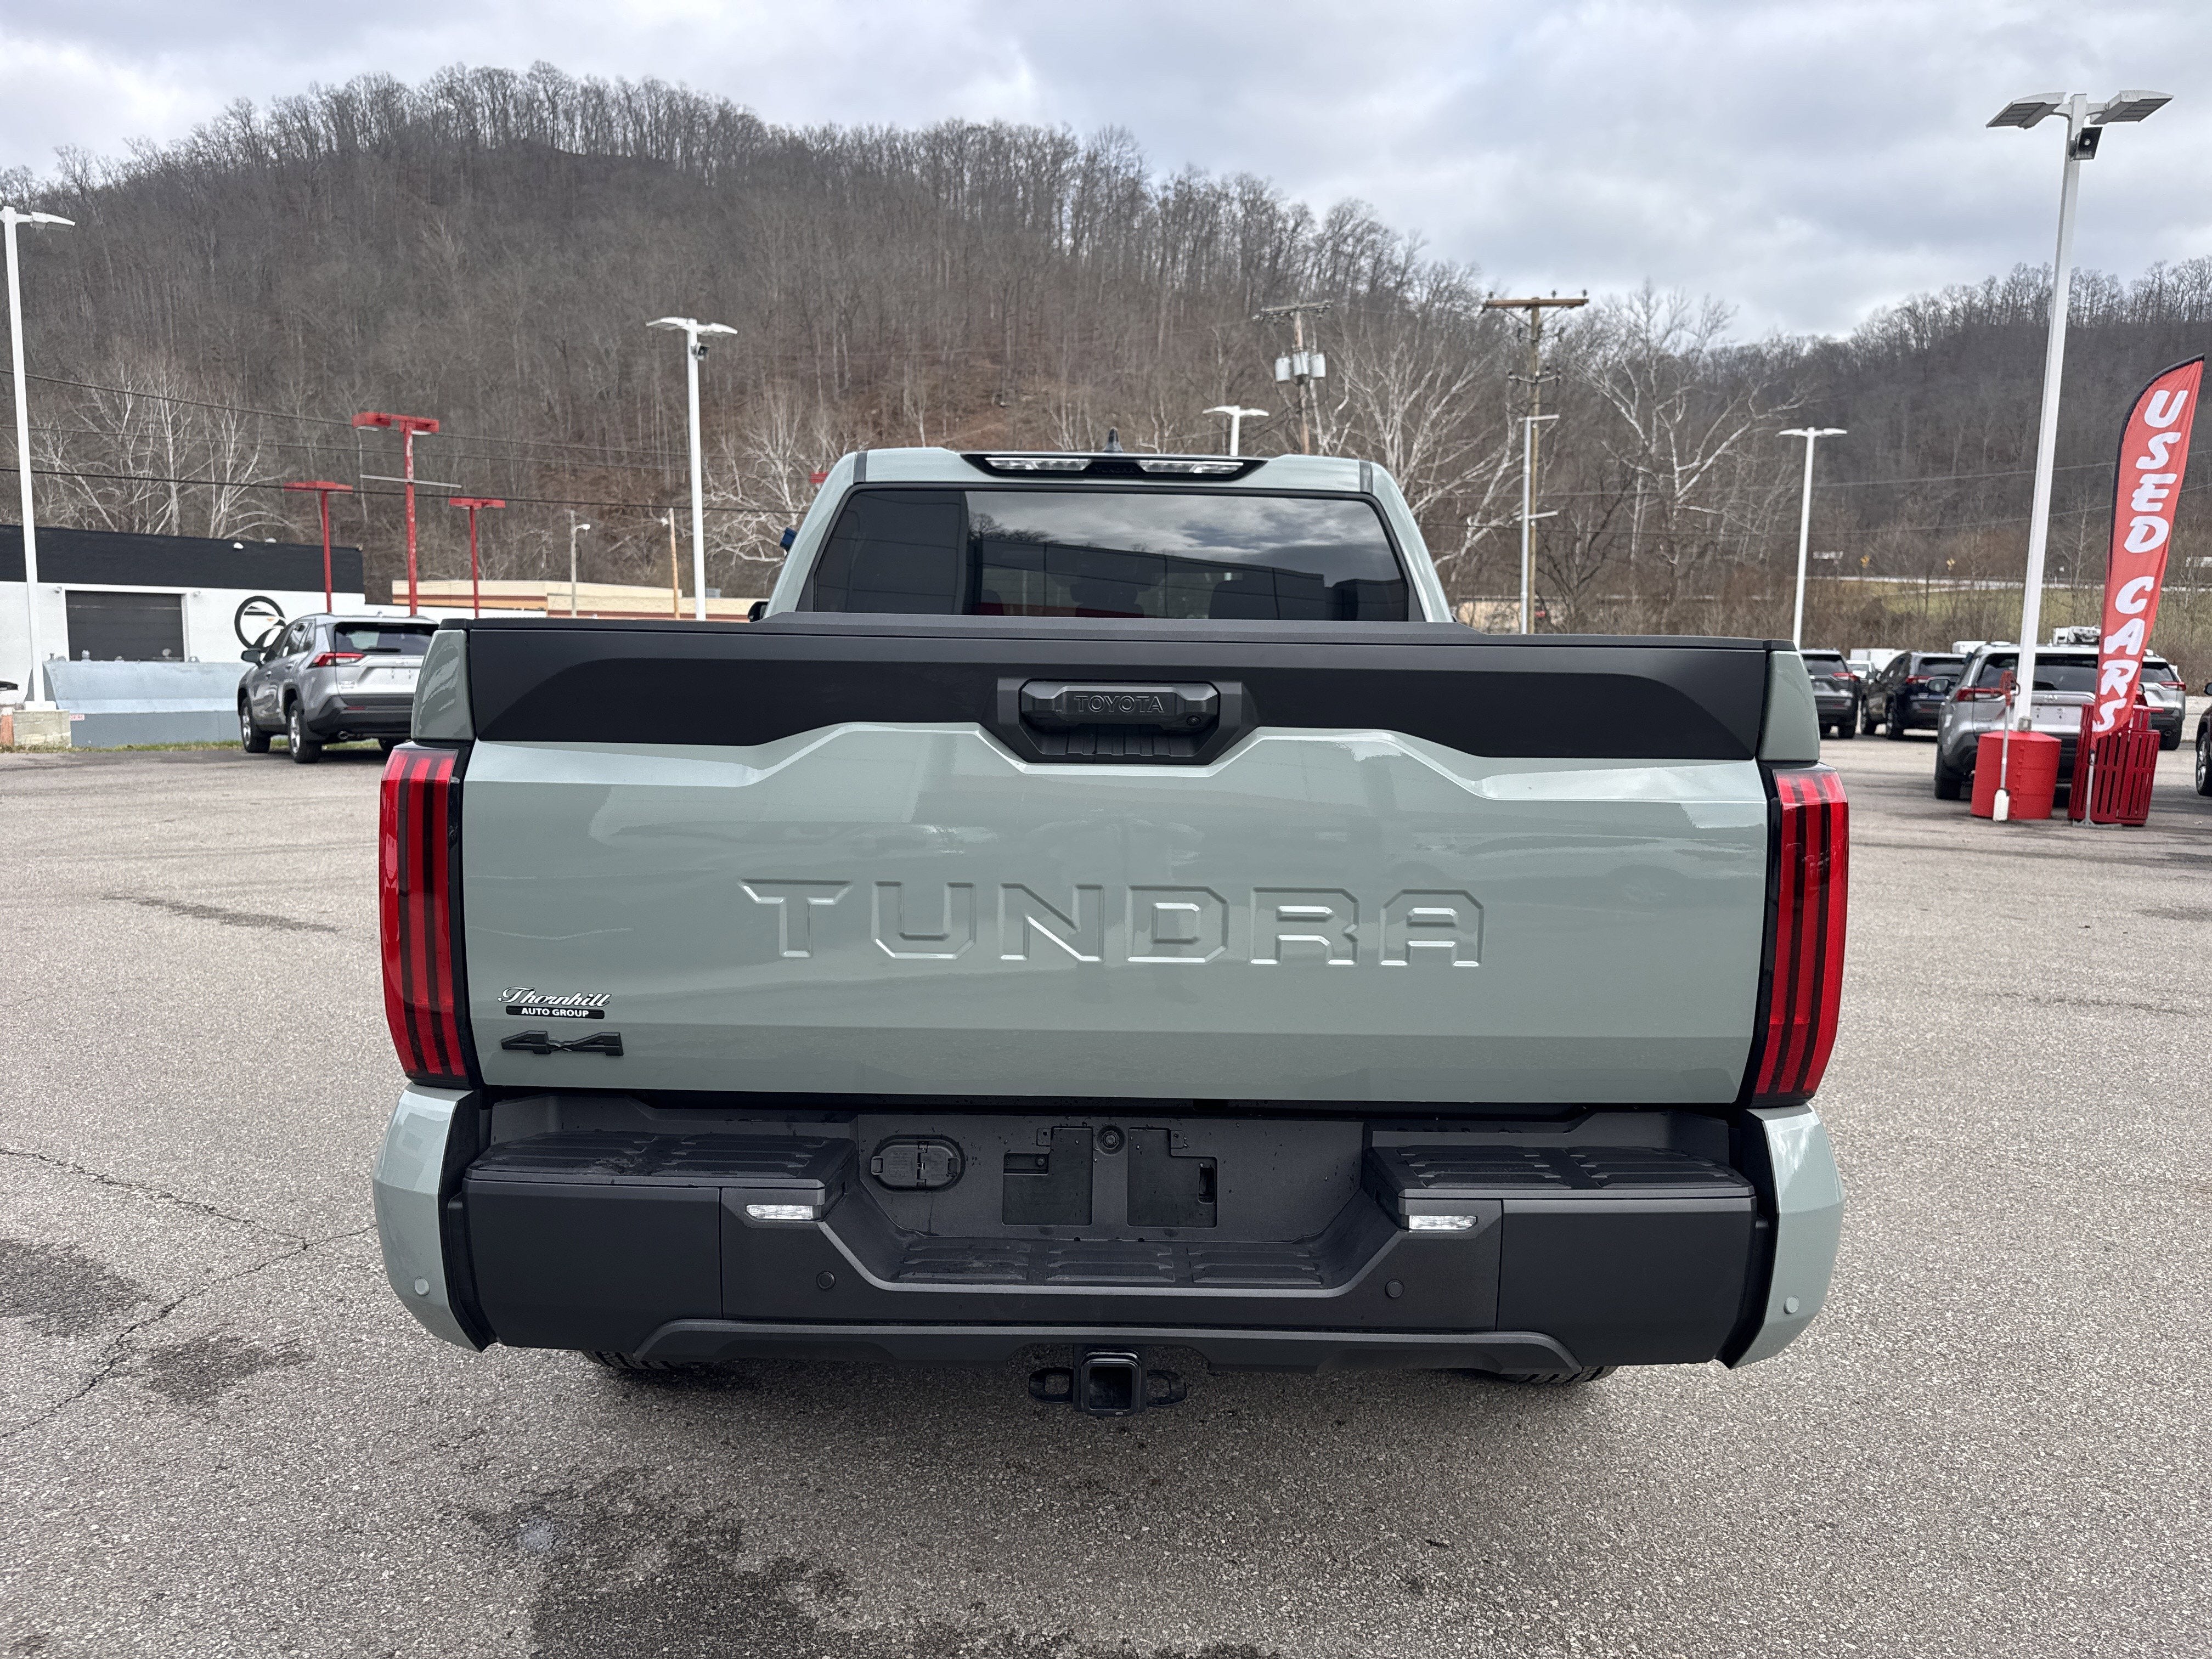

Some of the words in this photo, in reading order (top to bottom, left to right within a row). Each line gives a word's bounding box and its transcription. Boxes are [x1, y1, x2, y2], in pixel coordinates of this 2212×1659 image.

[2124, 390, 2188, 553] USED
[2092, 576, 2154, 732] CARS
[1074, 695, 1165, 713] TOYOTA
[739, 879, 1484, 967] TUNDRA
[498, 986, 612, 1007] Thornhill
[521, 1007, 550, 1015] AUTO
[552, 1009, 589, 1017] GROUP
